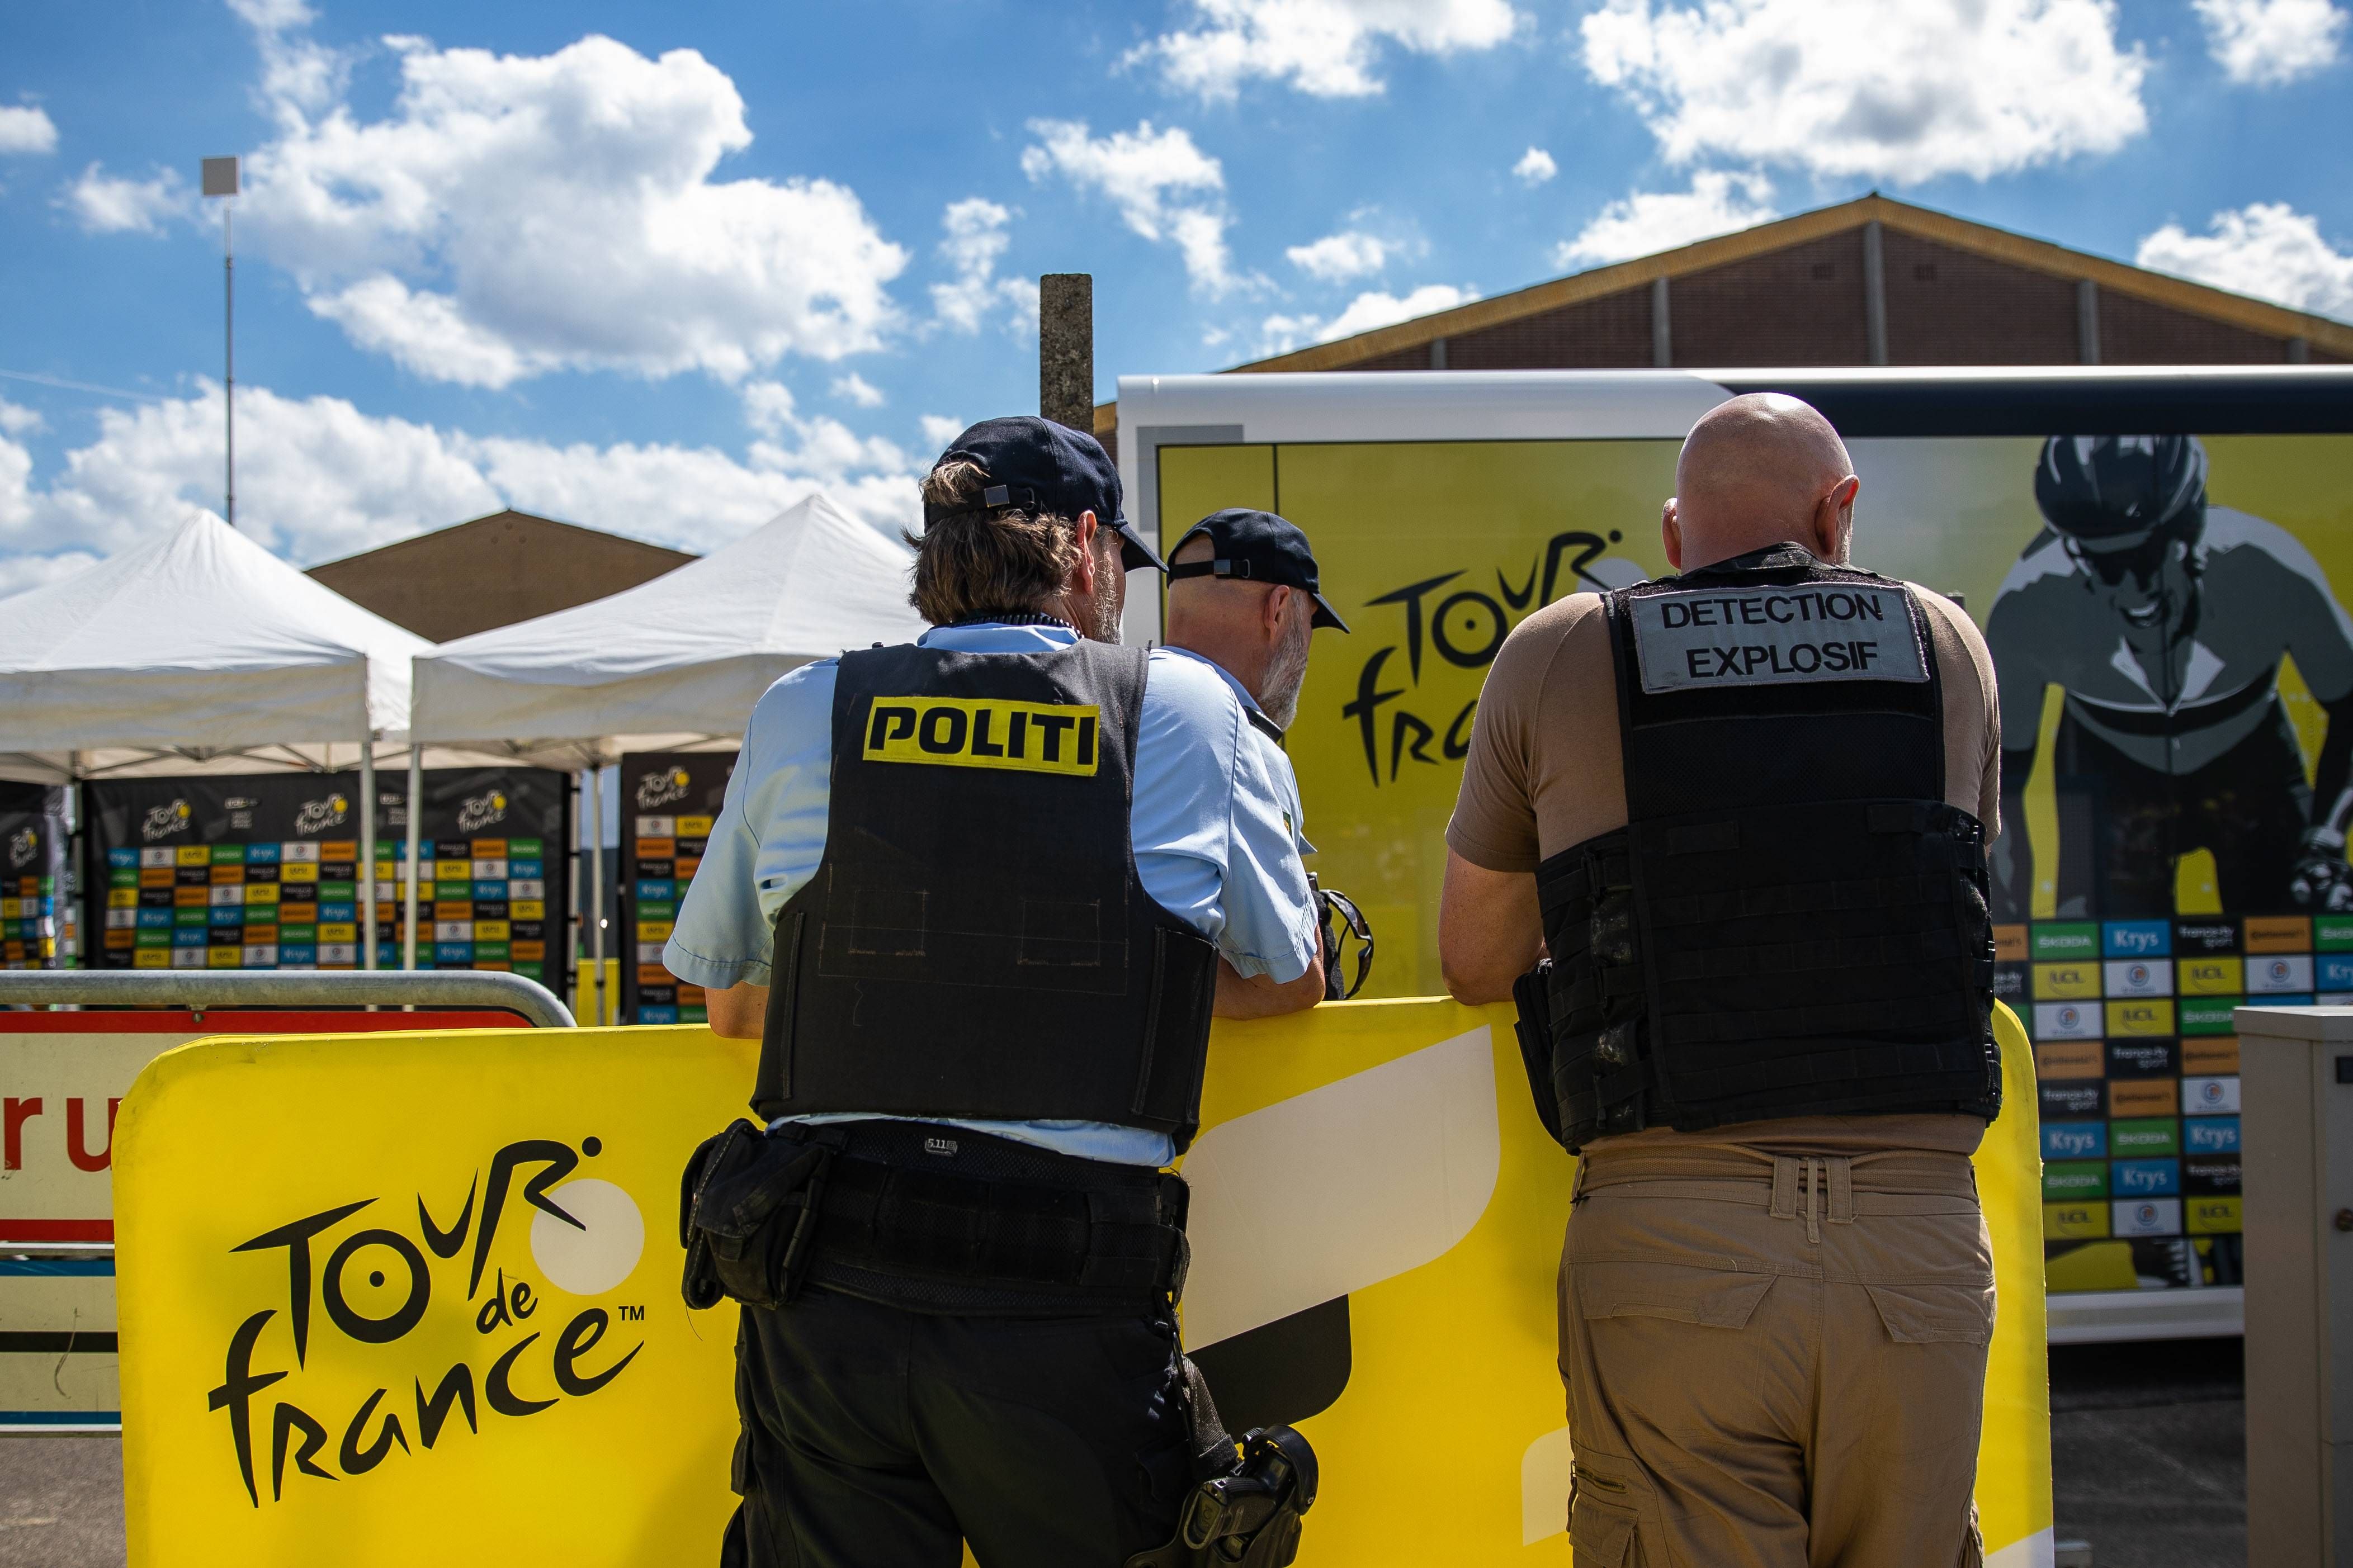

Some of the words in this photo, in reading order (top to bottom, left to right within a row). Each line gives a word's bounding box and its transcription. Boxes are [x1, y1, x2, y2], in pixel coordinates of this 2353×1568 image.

[1363, 529, 1622, 688] TOUR
[1661, 593, 1884, 629] DETECTION
[1686, 641, 1878, 678] EXPLOSIF
[868, 706, 1096, 765] POLITI
[2114, 929, 2159, 953] Krys
[928, 1138, 946, 1149] 5.11
[2049, 1130, 2095, 1154] Krys
[2189, 1125, 2237, 1149] Krys
[2122, 1165, 2167, 1190] Krys
[228, 1136, 602, 1372] TOUR
[476, 1267, 538, 1334] de
